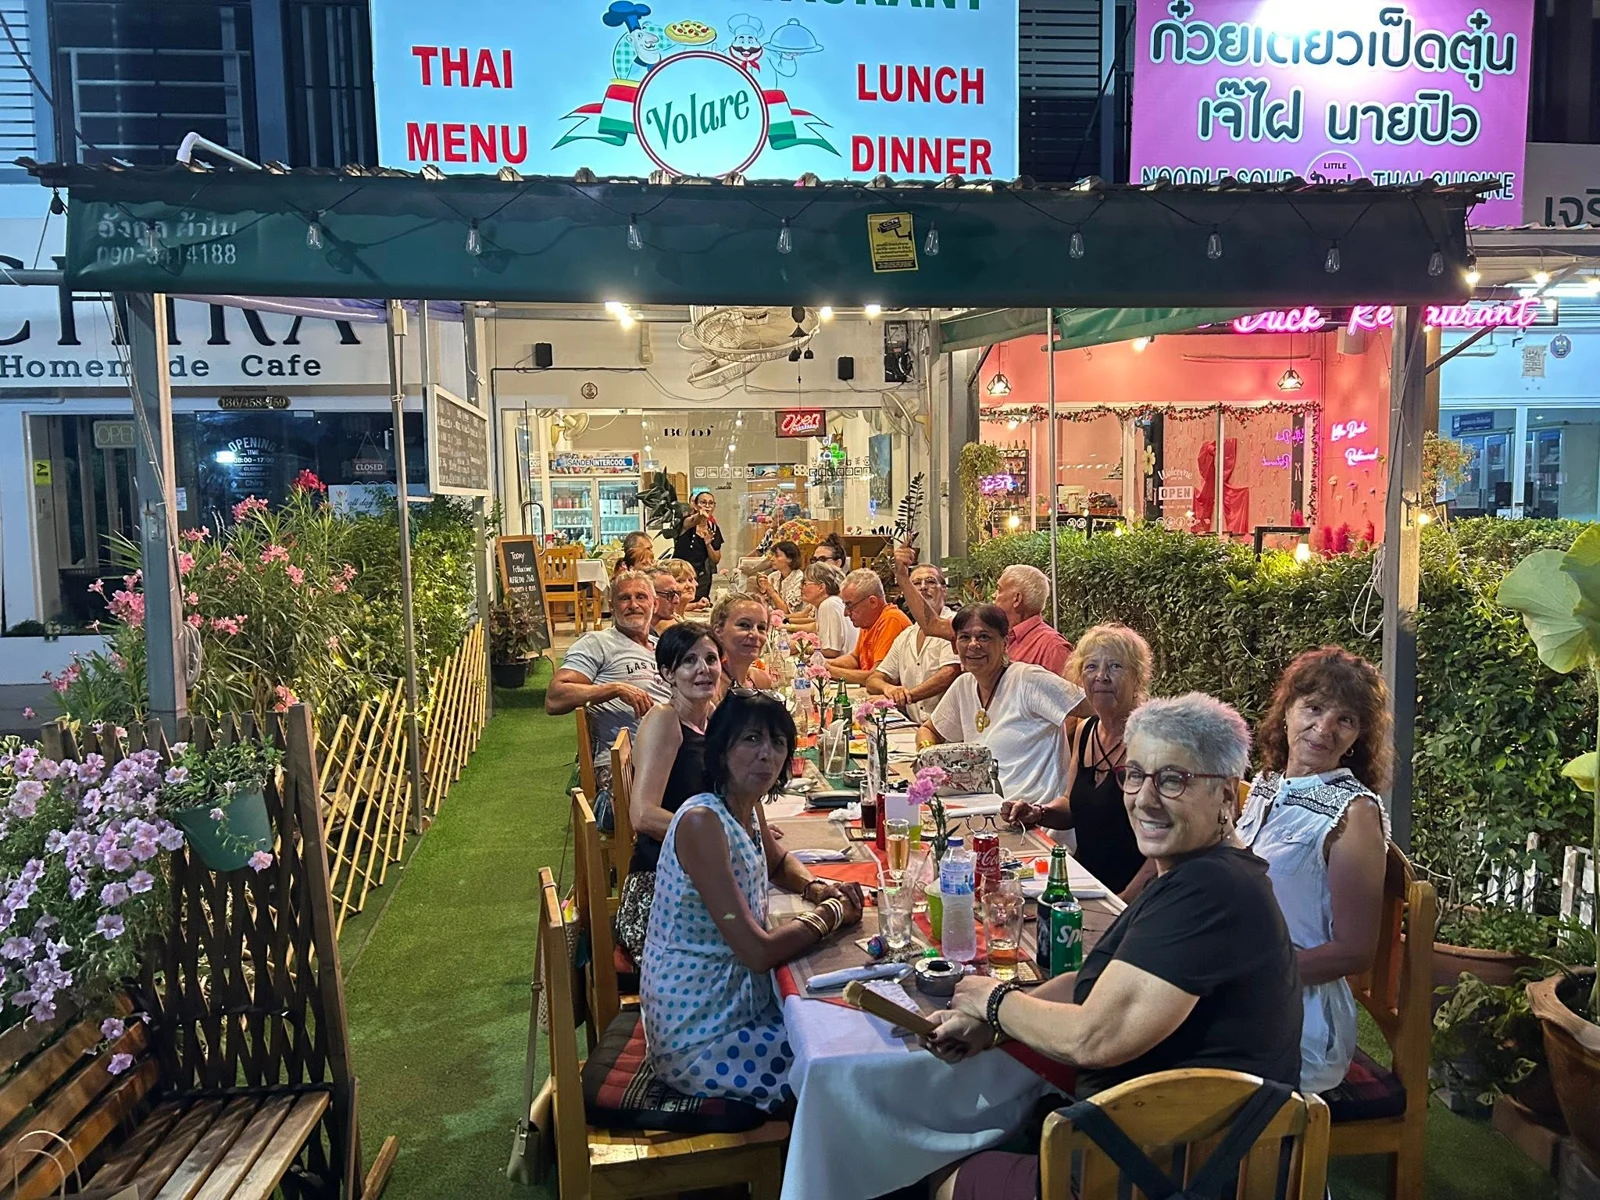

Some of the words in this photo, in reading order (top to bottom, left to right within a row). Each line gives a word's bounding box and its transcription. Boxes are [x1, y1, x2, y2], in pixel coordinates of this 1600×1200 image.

[412, 46, 513, 89] THAI
[857, 63, 984, 105] LUNCH
[646, 89, 749, 150] Volare
[1200, 80, 1302, 139] เจ๊ไฝ
[1328, 92, 1478, 142] นายปิว
[406, 122, 528, 164] MENU
[852, 135, 993, 175] DINNER
[1324, 162, 1347, 170] LITTLE
[241, 354, 322, 377] Cafe
[781, 413, 820, 434] Open
[228, 437, 277, 452] OPENING
[354, 462, 384, 472] CLOSED
[1161, 487, 1191, 499] OPEN
[626, 661, 647, 674] LAS
